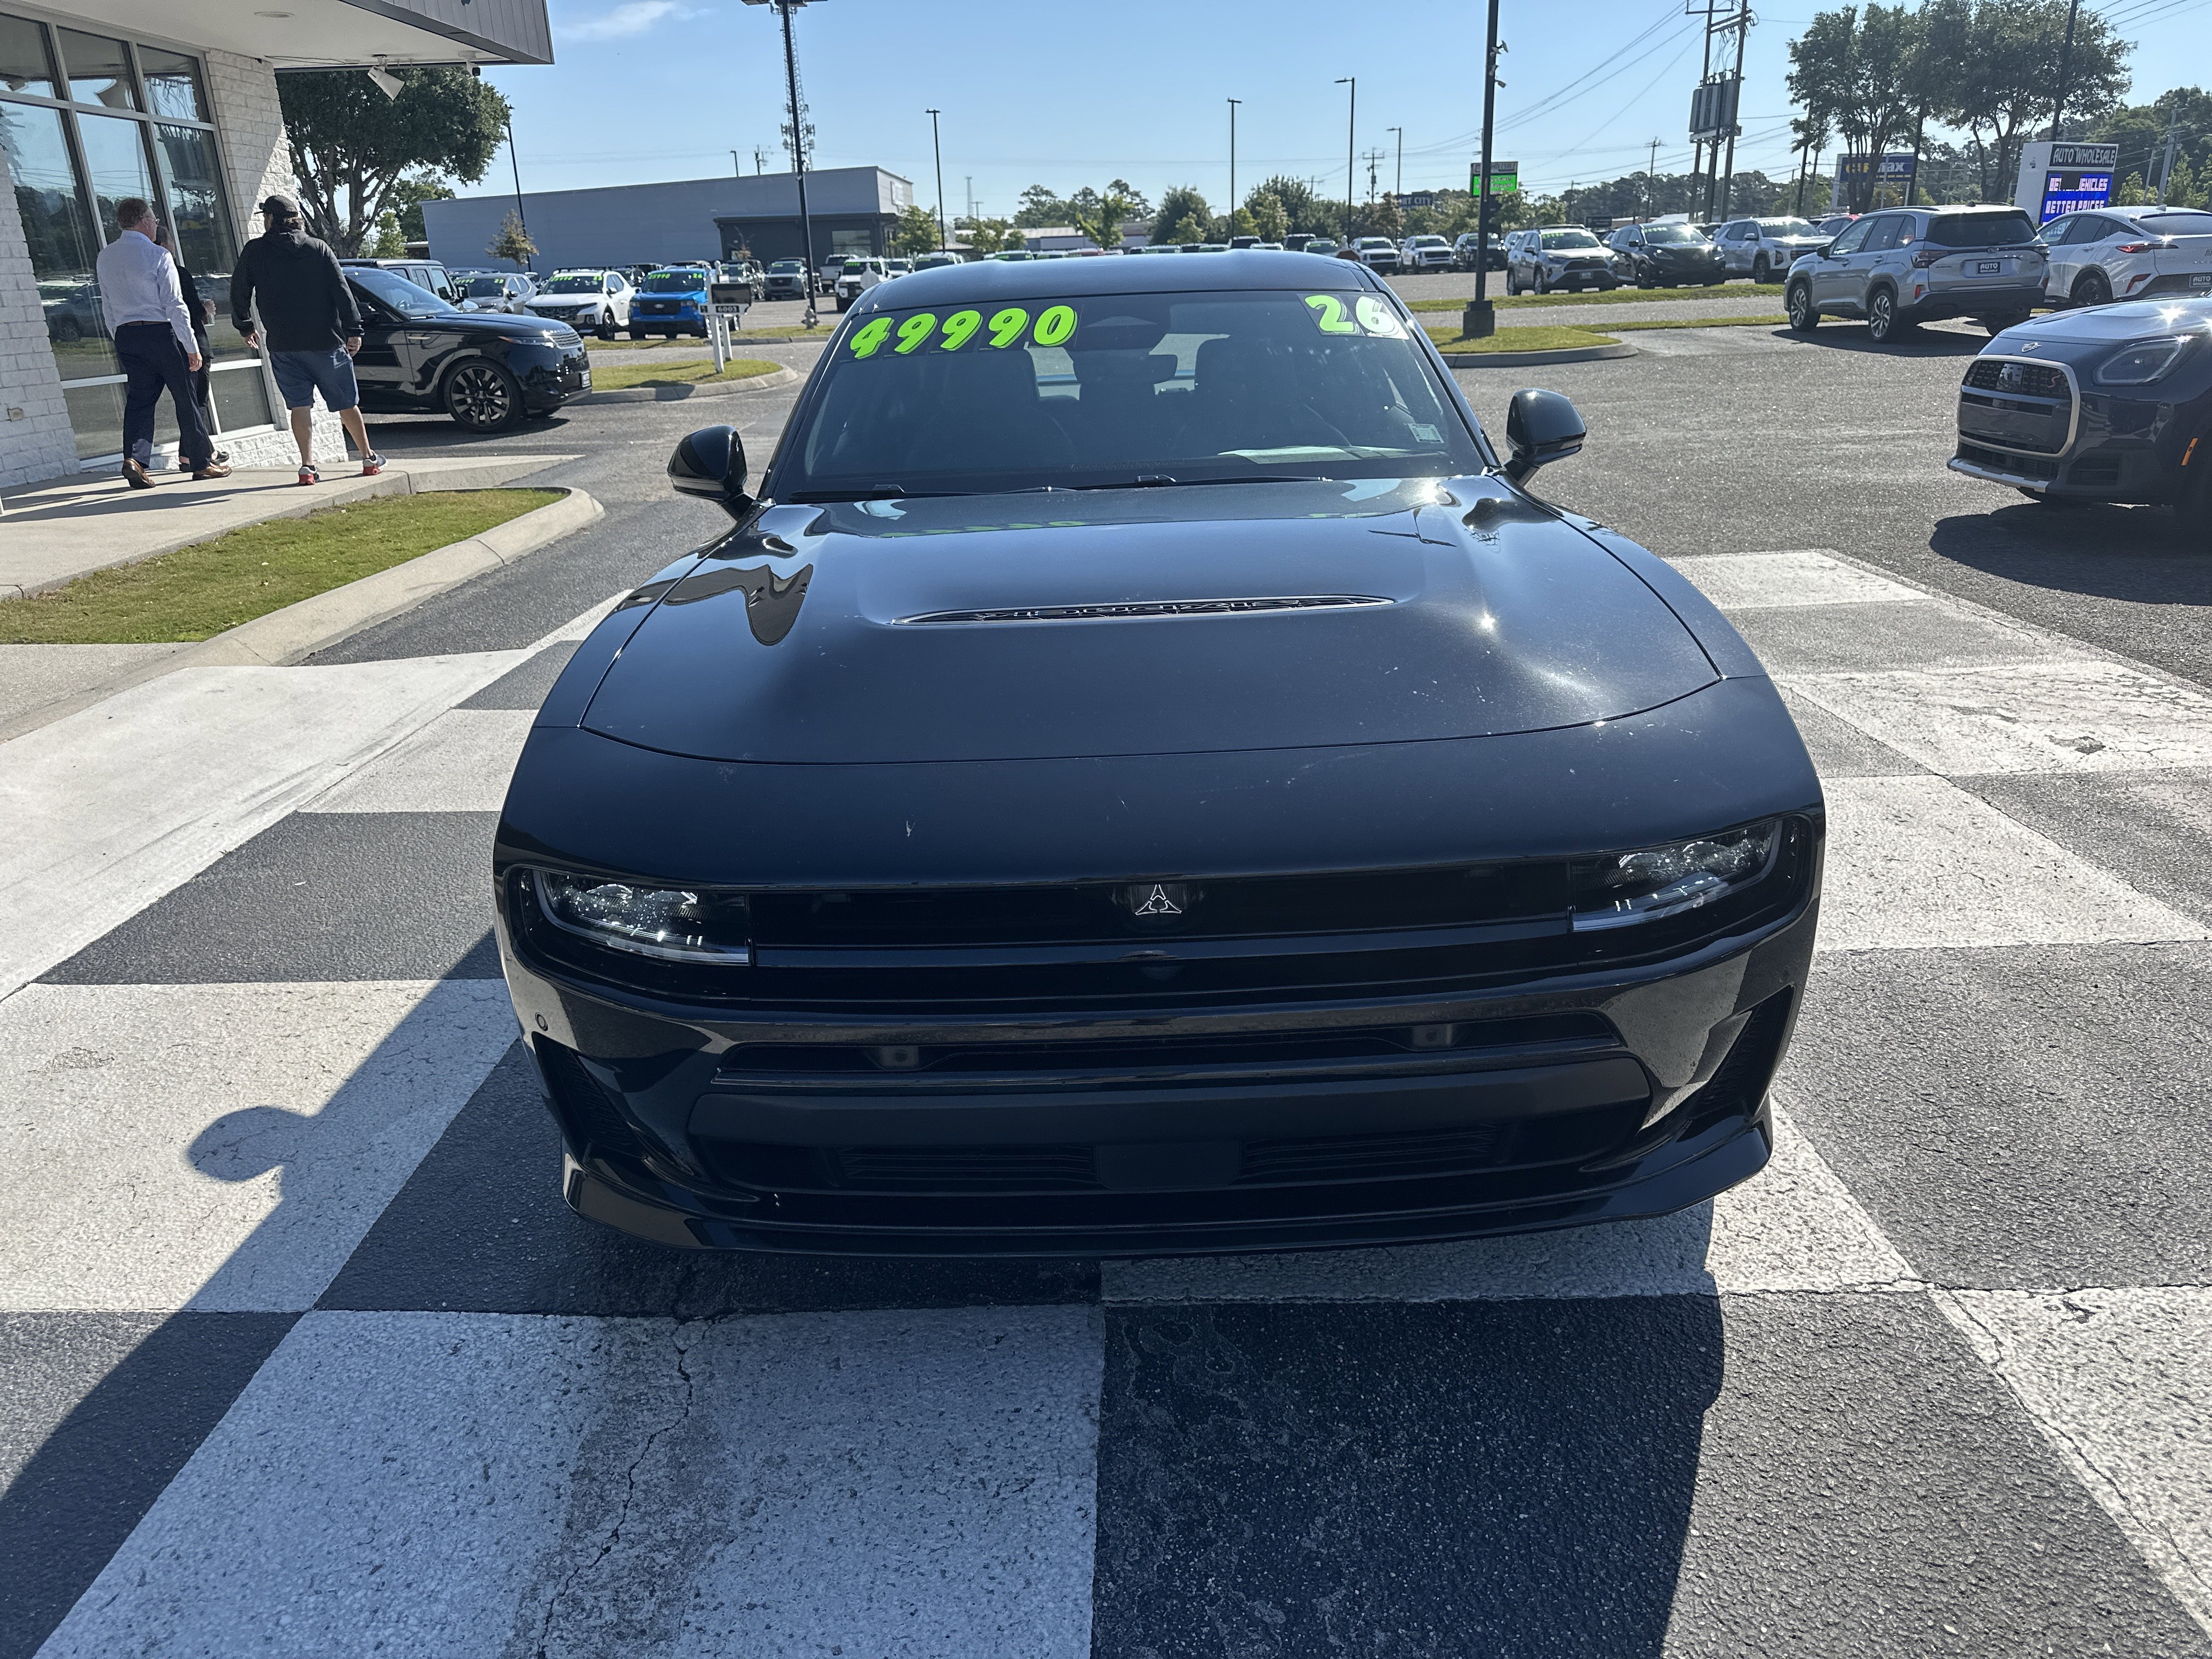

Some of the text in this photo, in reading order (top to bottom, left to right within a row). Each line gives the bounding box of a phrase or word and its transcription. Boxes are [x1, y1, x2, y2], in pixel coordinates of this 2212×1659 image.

[2053, 148, 2115, 165] AUTO WHOLESALE
[2045, 200, 2076, 214] BETTER
[850, 295, 1399, 359] 49990 26
